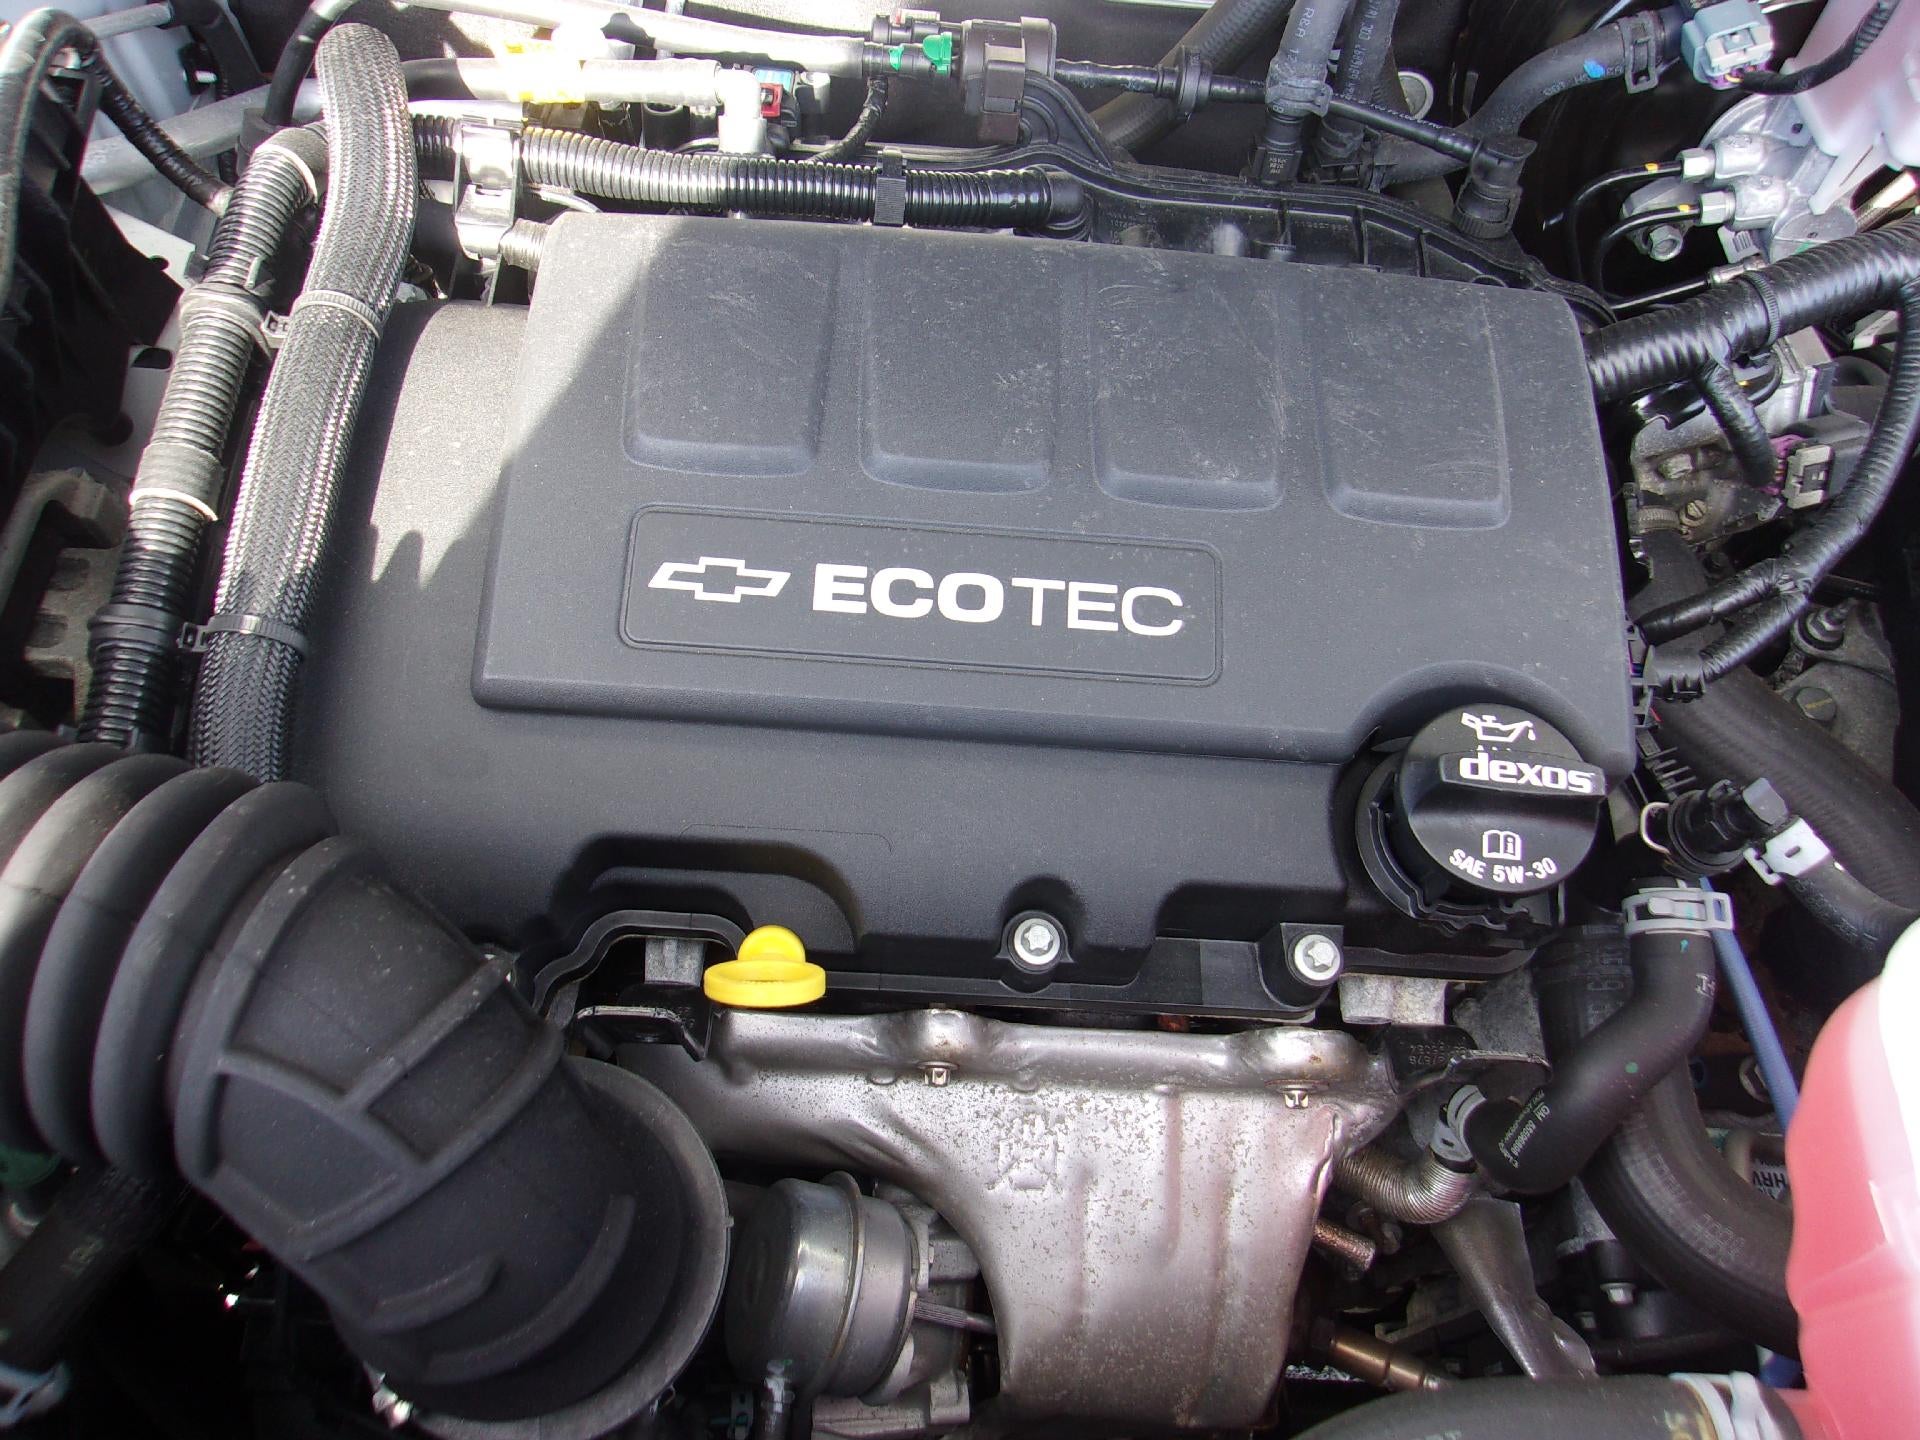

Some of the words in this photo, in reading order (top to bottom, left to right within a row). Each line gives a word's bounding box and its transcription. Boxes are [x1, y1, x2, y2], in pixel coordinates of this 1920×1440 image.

[811, 562, 1184, 637] ECOTEC
[1459, 749, 1596, 794] dexos
[1449, 849, 1487, 879] SAE
[1492, 857, 1557, 884] 5W-30
